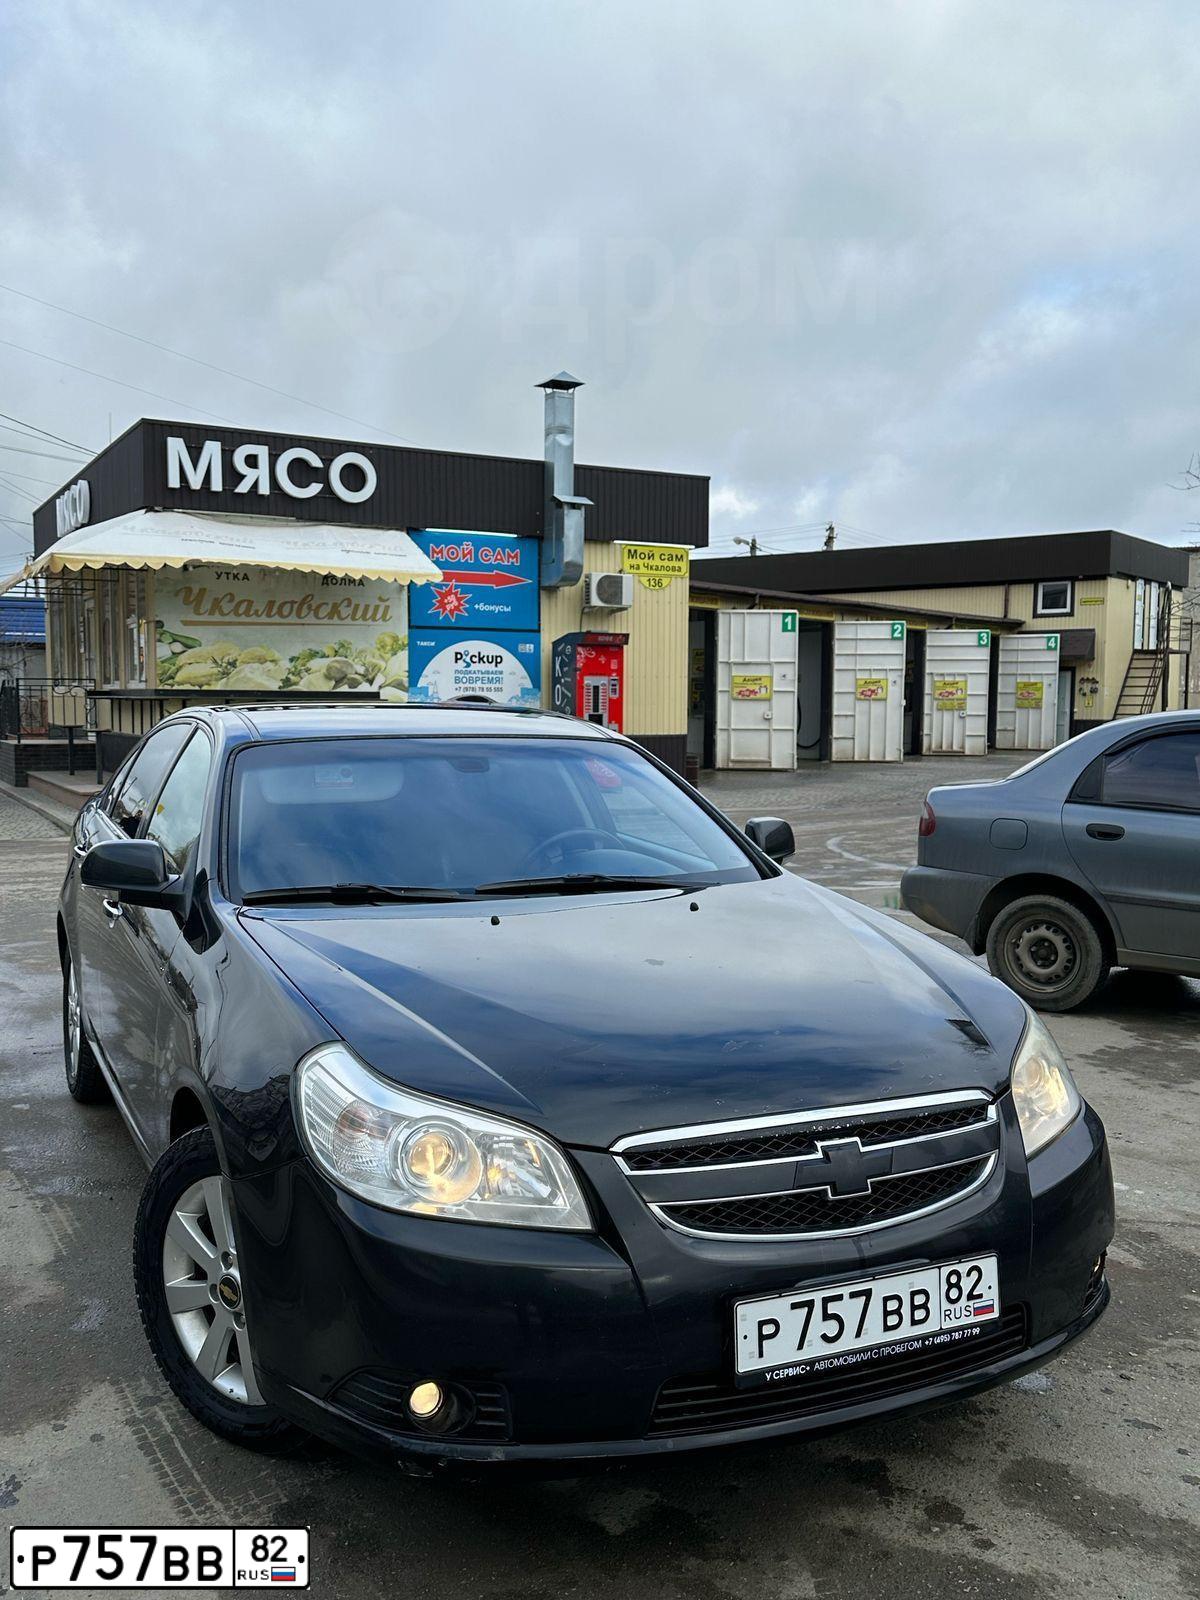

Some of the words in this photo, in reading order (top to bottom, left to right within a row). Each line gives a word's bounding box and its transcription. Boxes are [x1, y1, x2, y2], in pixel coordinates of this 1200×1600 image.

[166, 436, 378, 504] МЯСО
[430, 541, 475, 563] МОЙ
[478, 547, 521, 566] САМ
[627, 549, 655, 560] Мой
[659, 552, 684, 562] сам
[629, 563, 640, 571] на
[643, 562, 682, 573] Чкалова
[214, 571, 250, 582] УТКА
[321, 574, 366, 588] ДОЛМА
[646, 577, 663, 588] 136
[175, 586, 394, 623] Чкаловский
[473, 602, 512, 613] +бонусы
[783, 615, 793, 631] 1
[893, 623, 904, 638] 2
[979, 631, 989, 645] 3
[1047, 636, 1057, 650] 4
[454, 676, 504, 685] ВОВРЕМЯ!
[757, 1287, 931, 1359] Р757ВВ
[944, 1264, 984, 1305] 82
[943, 1305, 973, 1323] RUS
[765, 1372, 772, 1381] У
[772, 1364, 811, 1380] СЕРВИС+
[813, 1349, 871, 1371] АВТОМОБИЛИ
[871, 1348, 879, 1359] С
[879, 1339, 922, 1357] ПРОБЕГОМ
[924, 1338, 933, 1348] +7
[934, 1333, 951, 1346] (495)
[951, 1330, 962, 1341] 787
[963, 1328, 971, 1339] 77
[971, 1326, 981, 1337] 99
